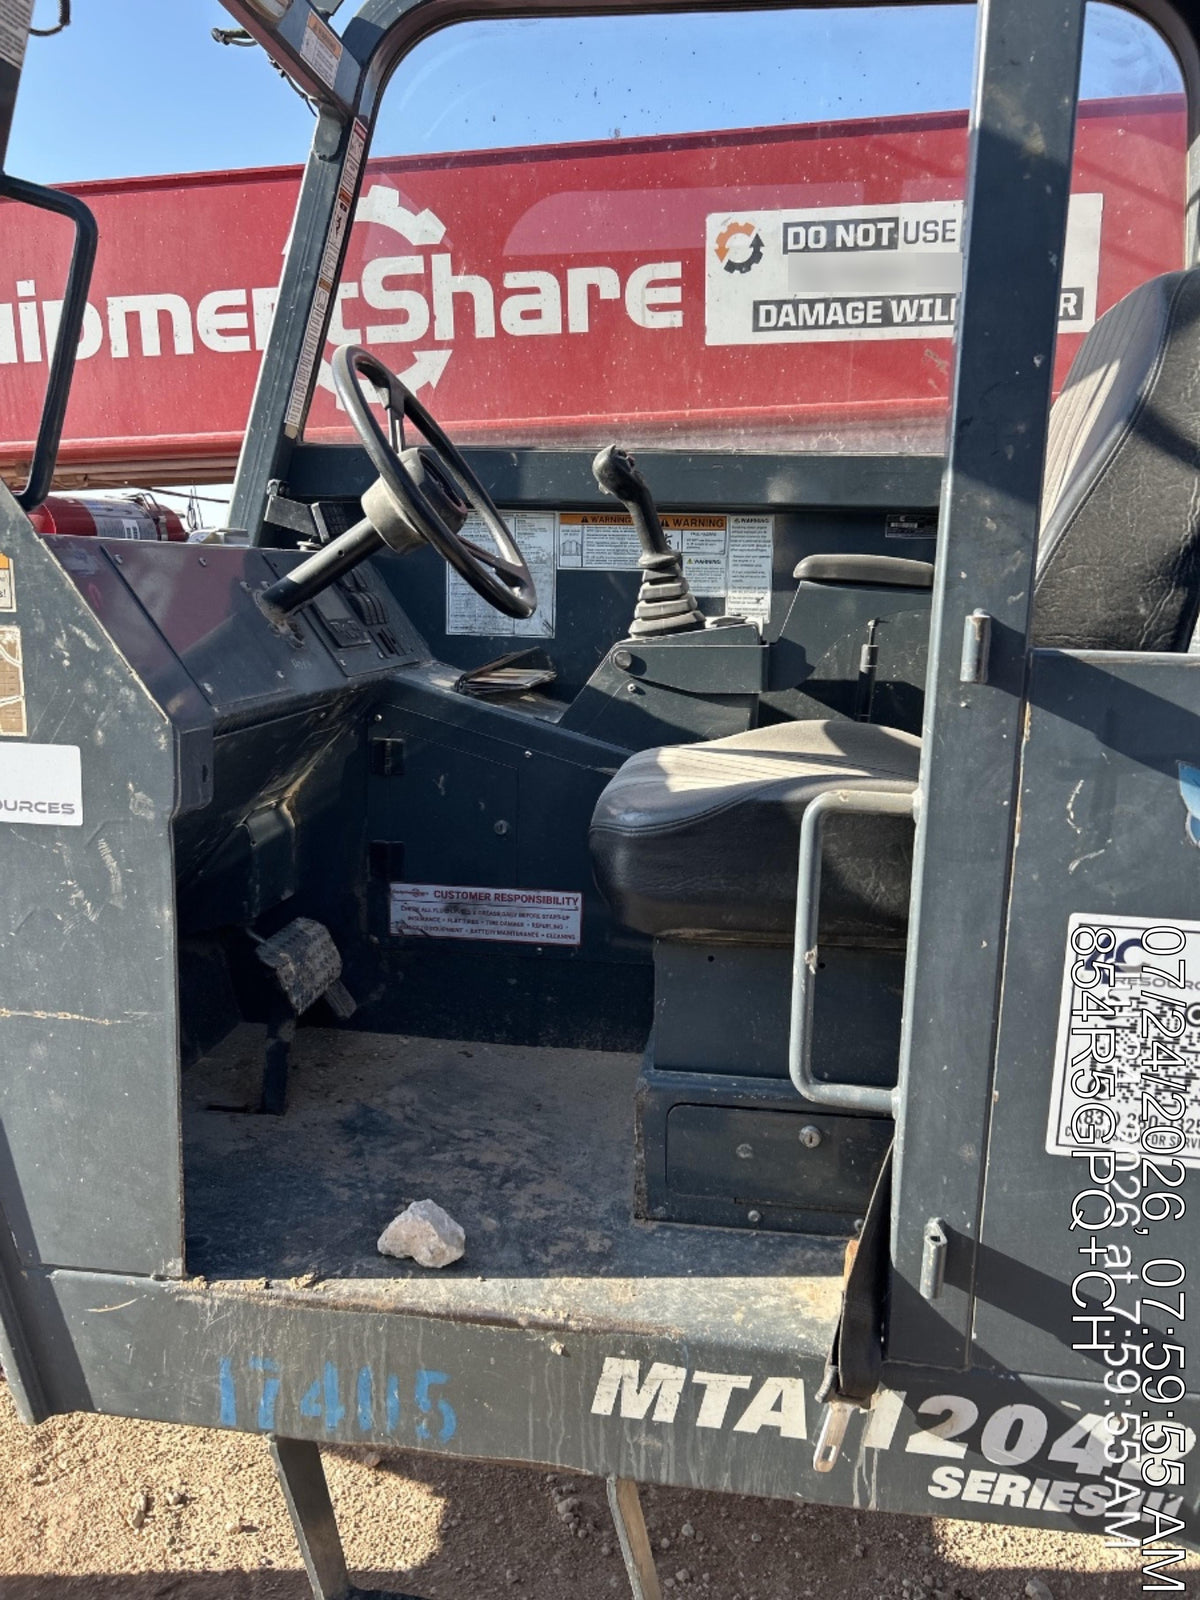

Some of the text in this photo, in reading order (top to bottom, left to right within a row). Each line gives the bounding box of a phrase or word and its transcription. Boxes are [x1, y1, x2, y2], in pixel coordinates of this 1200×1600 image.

[786, 219, 957, 251] DO NOT USE
[0, 253, 683, 371] ipmetShare
[757, 300, 883, 328] DAMAGE
[590, 514, 632, 524] WARNING
[672, 516, 724, 529] WARNING
[0, 799, 76, 815] URCES
[433, 889, 492, 902] CUSTOMER
[494, 891, 580, 907] RESPONSIBILITY
[219, 1356, 457, 1443] 17405
[590, 1356, 808, 1440] MTA
[927, 1466, 1114, 1518] SERIES
